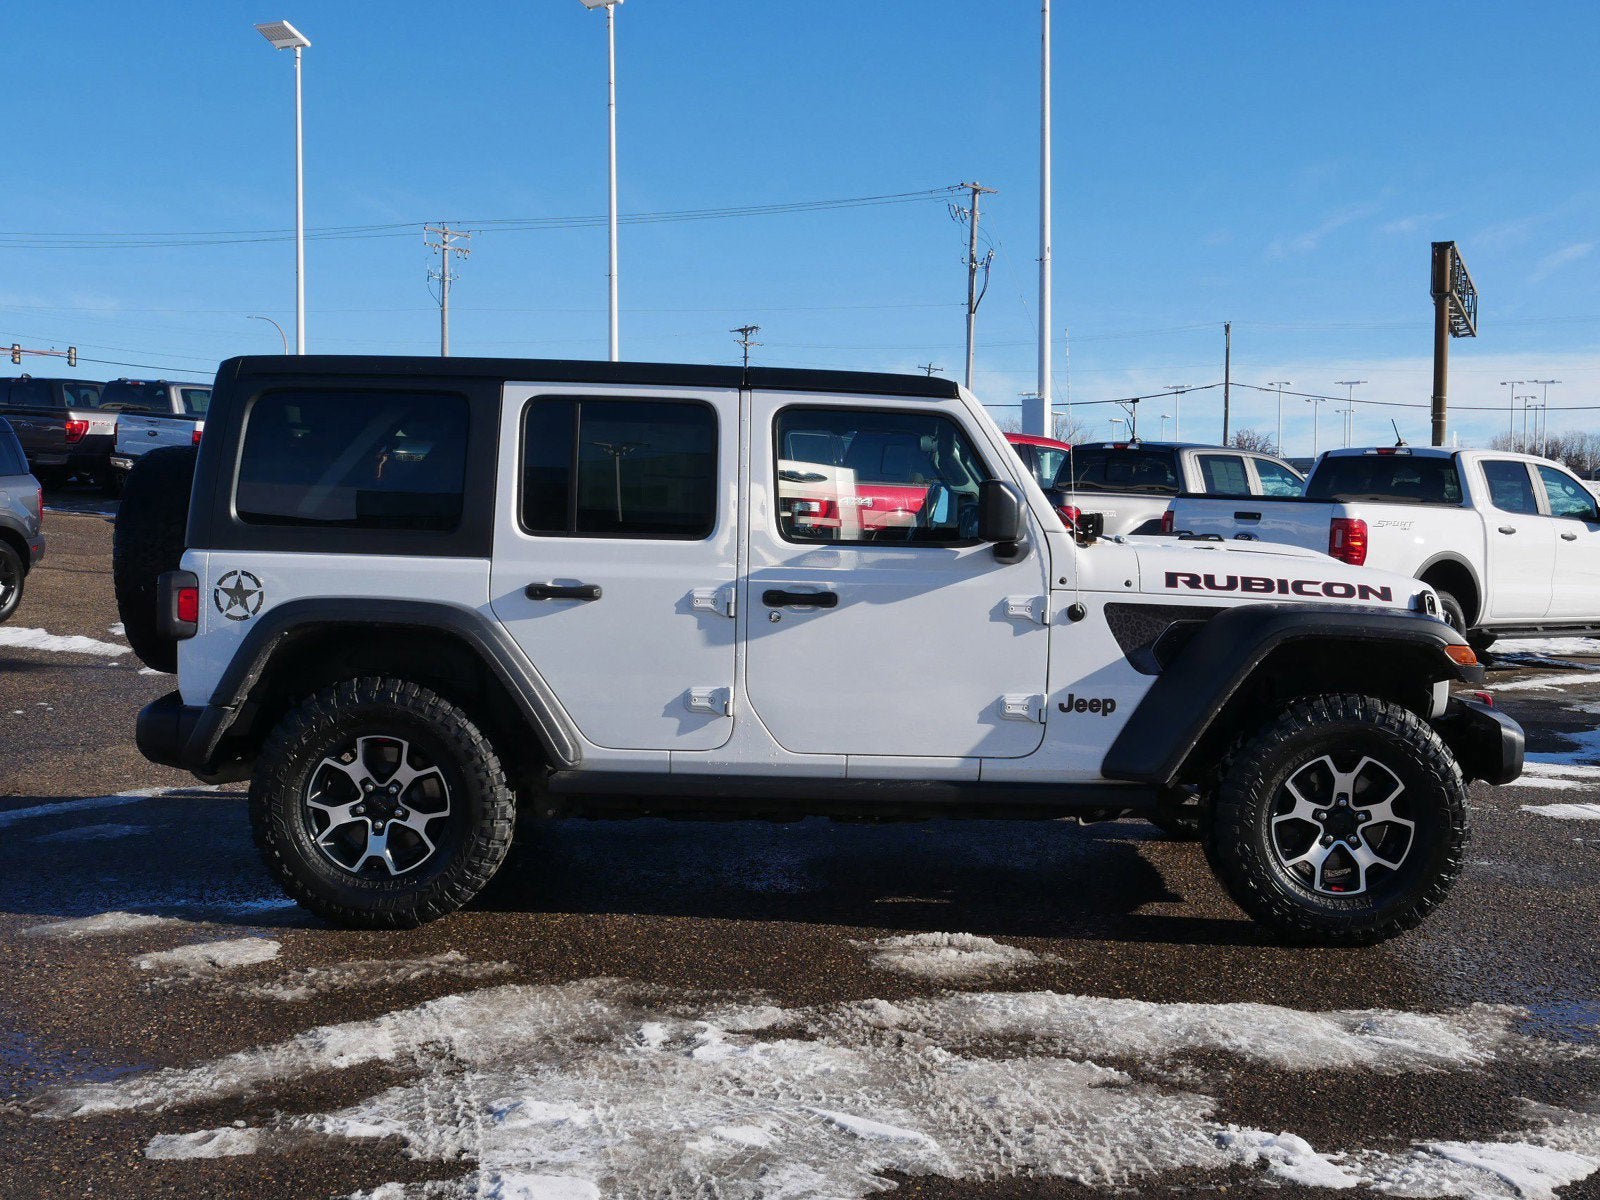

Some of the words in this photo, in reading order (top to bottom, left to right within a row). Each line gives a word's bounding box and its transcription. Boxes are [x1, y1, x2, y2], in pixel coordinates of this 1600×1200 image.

[1372, 519, 1415, 528] SPORT
[1164, 571, 1393, 602] RUBICON
[1058, 693, 1117, 717] Jeep
